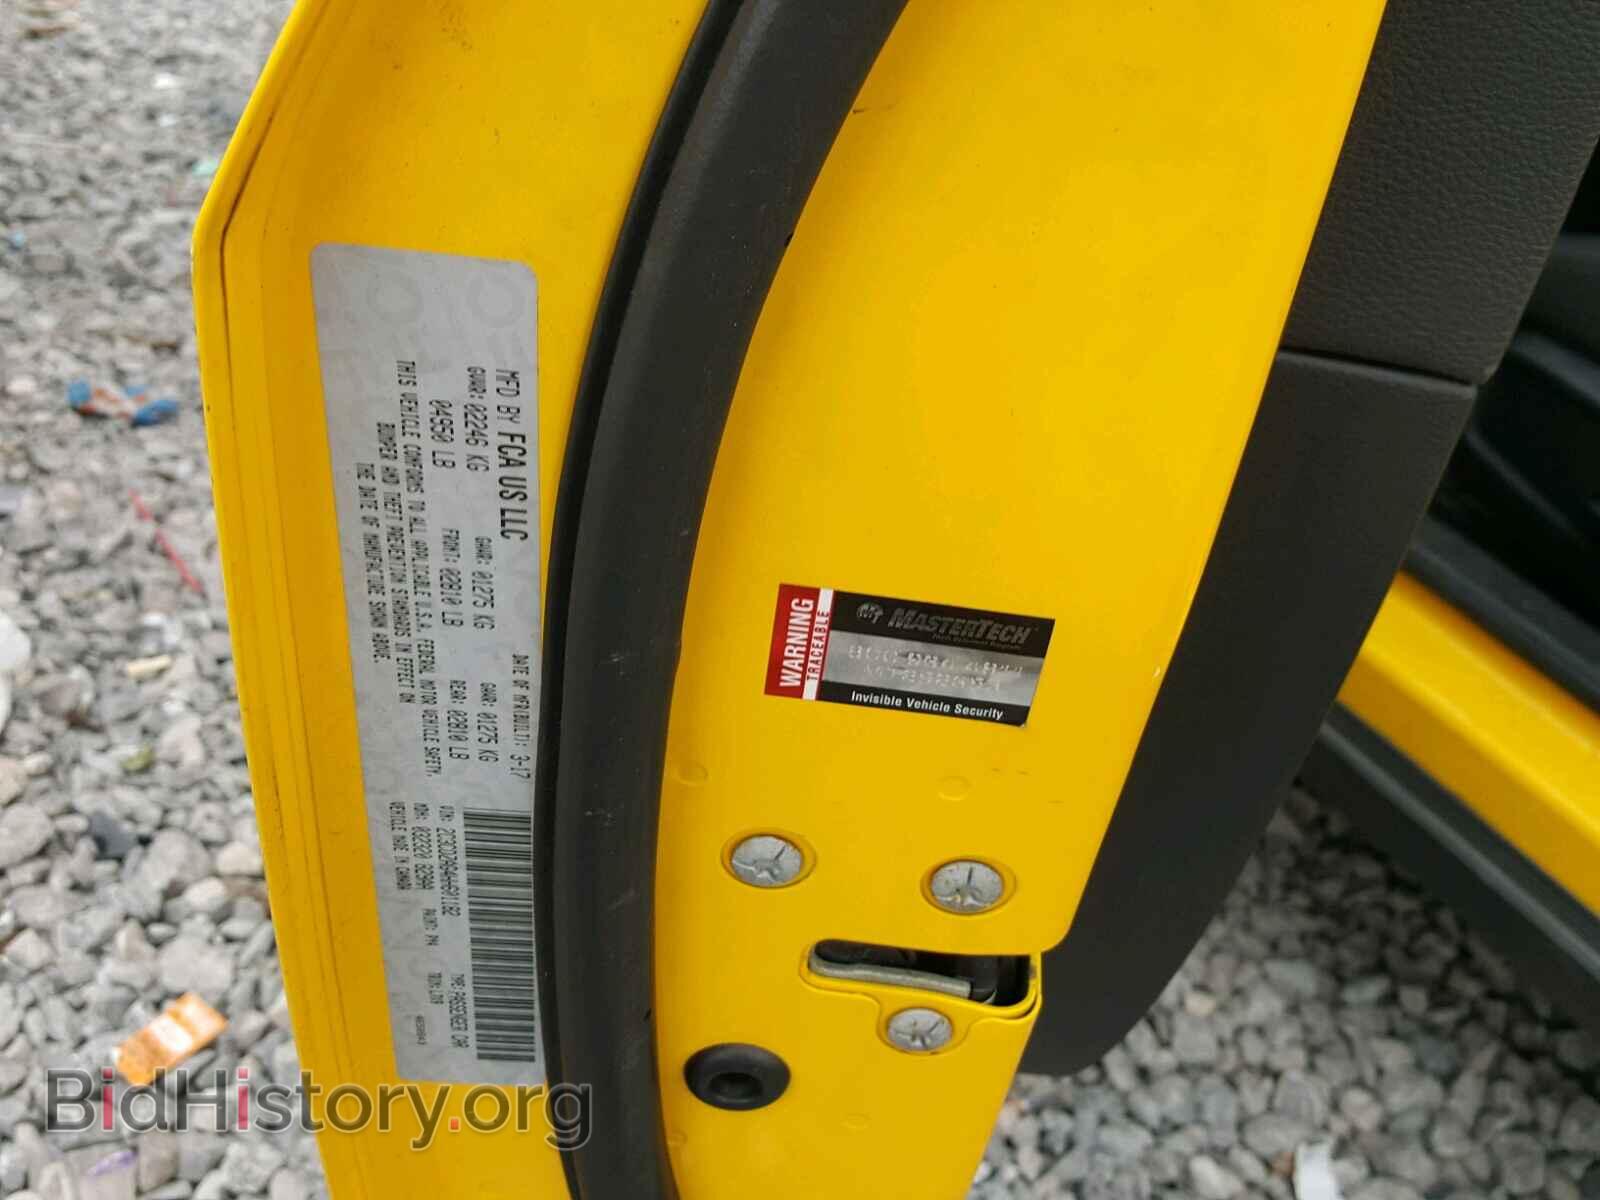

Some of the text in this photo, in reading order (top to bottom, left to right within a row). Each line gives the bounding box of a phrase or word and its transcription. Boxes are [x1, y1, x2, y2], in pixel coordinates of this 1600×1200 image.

[397, 360, 416, 386] THIS
[400, 392, 420, 438] VEHICLE
[464, 366, 489, 472] GVWR: 02246 KG
[429, 399, 456, 469] 04950 LB
[356, 463, 375, 480] THE
[403, 444, 424, 493] CONFORMS
[496, 369, 528, 541] MFD BY FCA US LLC
[359, 485, 378, 510] DATE
[408, 501, 425, 512] TO
[361, 516, 379, 528] OF
[409, 516, 427, 533] ALL
[363, 532, 386, 595] MANUFACTURE
[376, 422, 415, 704] BUMPER AND THEFT PREVENTION STANDARDS IN EFFECT ON
[411, 541, 431, 597] APPLICABLE
[440, 528, 463, 627] FRONT: 02810 LB
[472, 536, 495, 630] GAWR: 01275 KG
[368, 601, 388, 628] SHOWN
[417, 640, 434, 674] FEDERAL
[779, 597, 814, 688] WARNING
[806, 610, 830, 681] TRACEABLE
[512, 654, 529, 674] DATE
[419, 680, 437, 705] MOTOR
[513, 680, 529, 690] OF
[447, 680, 469, 760] REAR: 02810 LB
[477, 682, 498, 762] GAWR: 01275 KG
[851, 690, 1004, 721] Invisible Vehicle Security
[422, 709, 439, 742] VEHICLE
[510, 754, 530, 779] 3-17
[390, 802, 407, 831] VEHICLE
